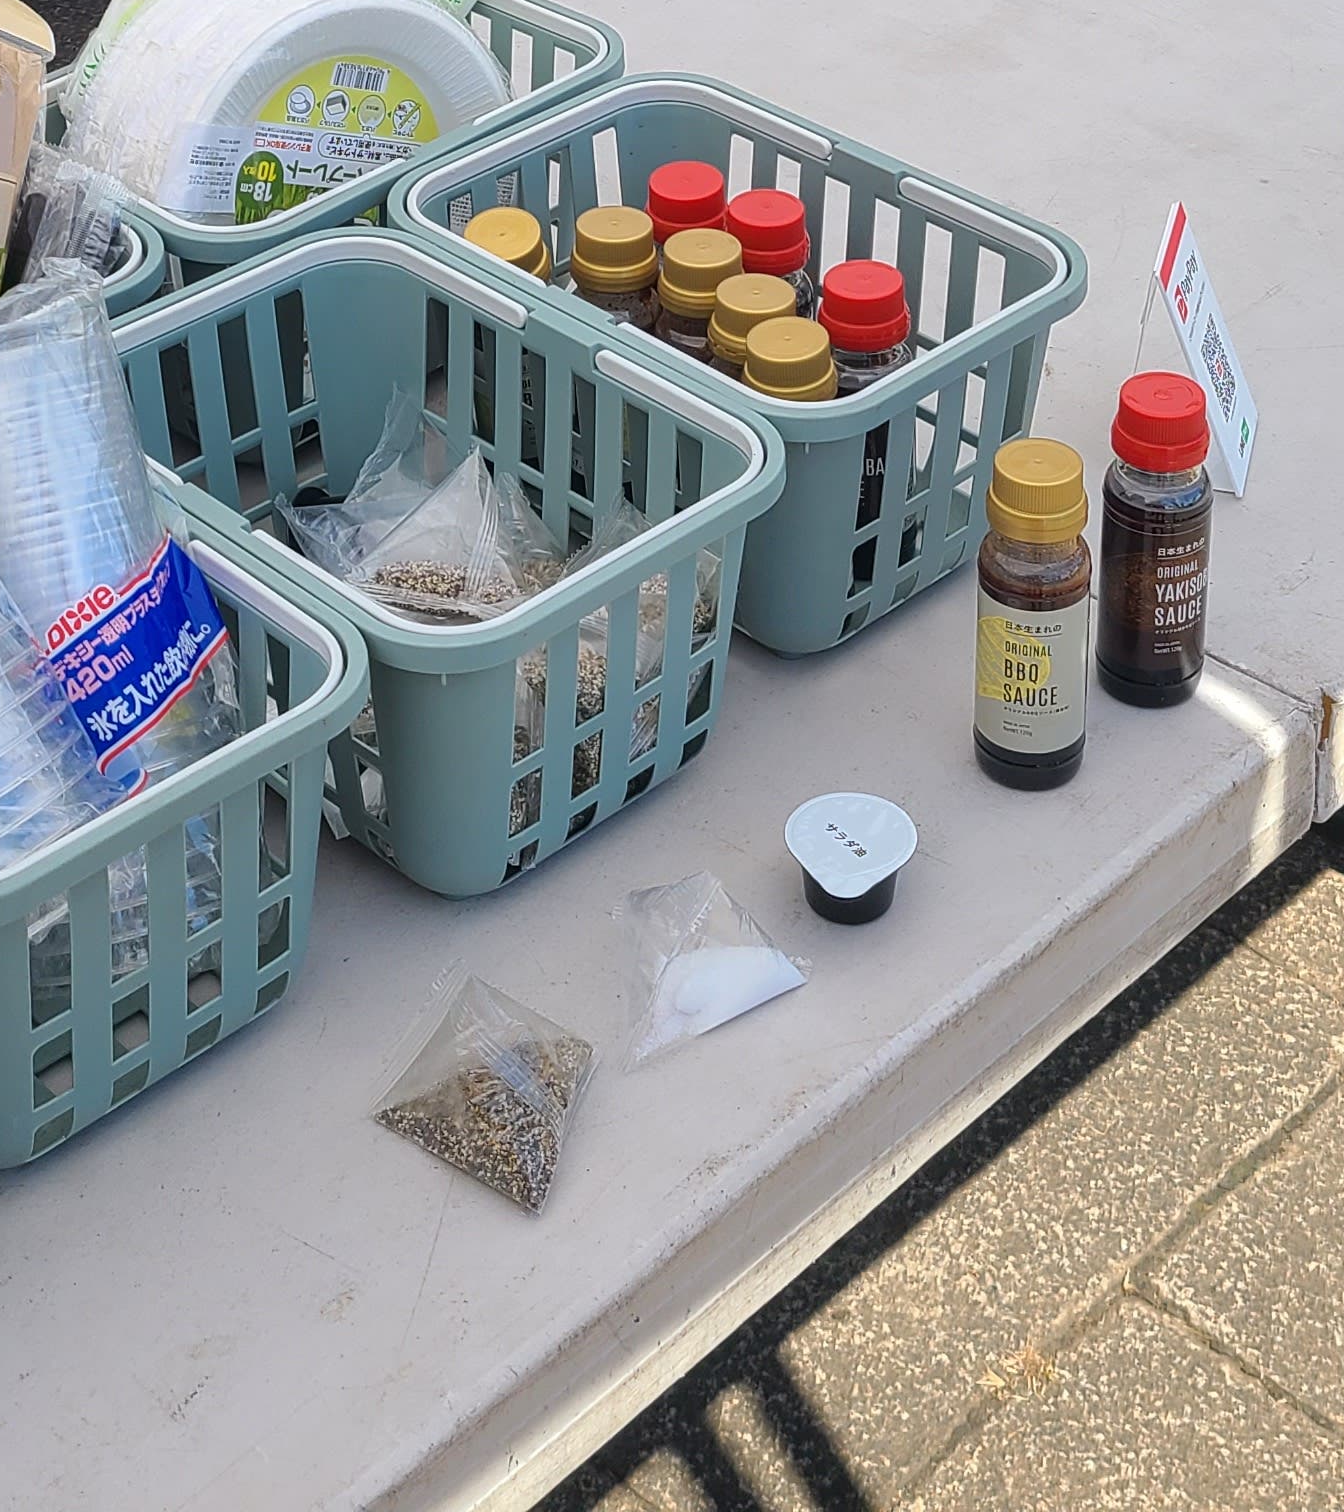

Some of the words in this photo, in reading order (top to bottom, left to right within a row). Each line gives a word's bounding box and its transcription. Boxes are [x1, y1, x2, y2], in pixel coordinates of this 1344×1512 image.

[1157, 560, 1198, 579] ORIGINAL
[1154, 595, 1202, 626] SAUCE
[1005, 620, 1062, 634] 日本生まれの
[1005, 640, 1053, 657] ORIGINAL
[65, 644, 135, 704] 420ml
[1004, 658, 1039, 685] BBQ
[1003, 683, 1058, 707] SAUCE
[825, 822, 868, 858] サラダ油
